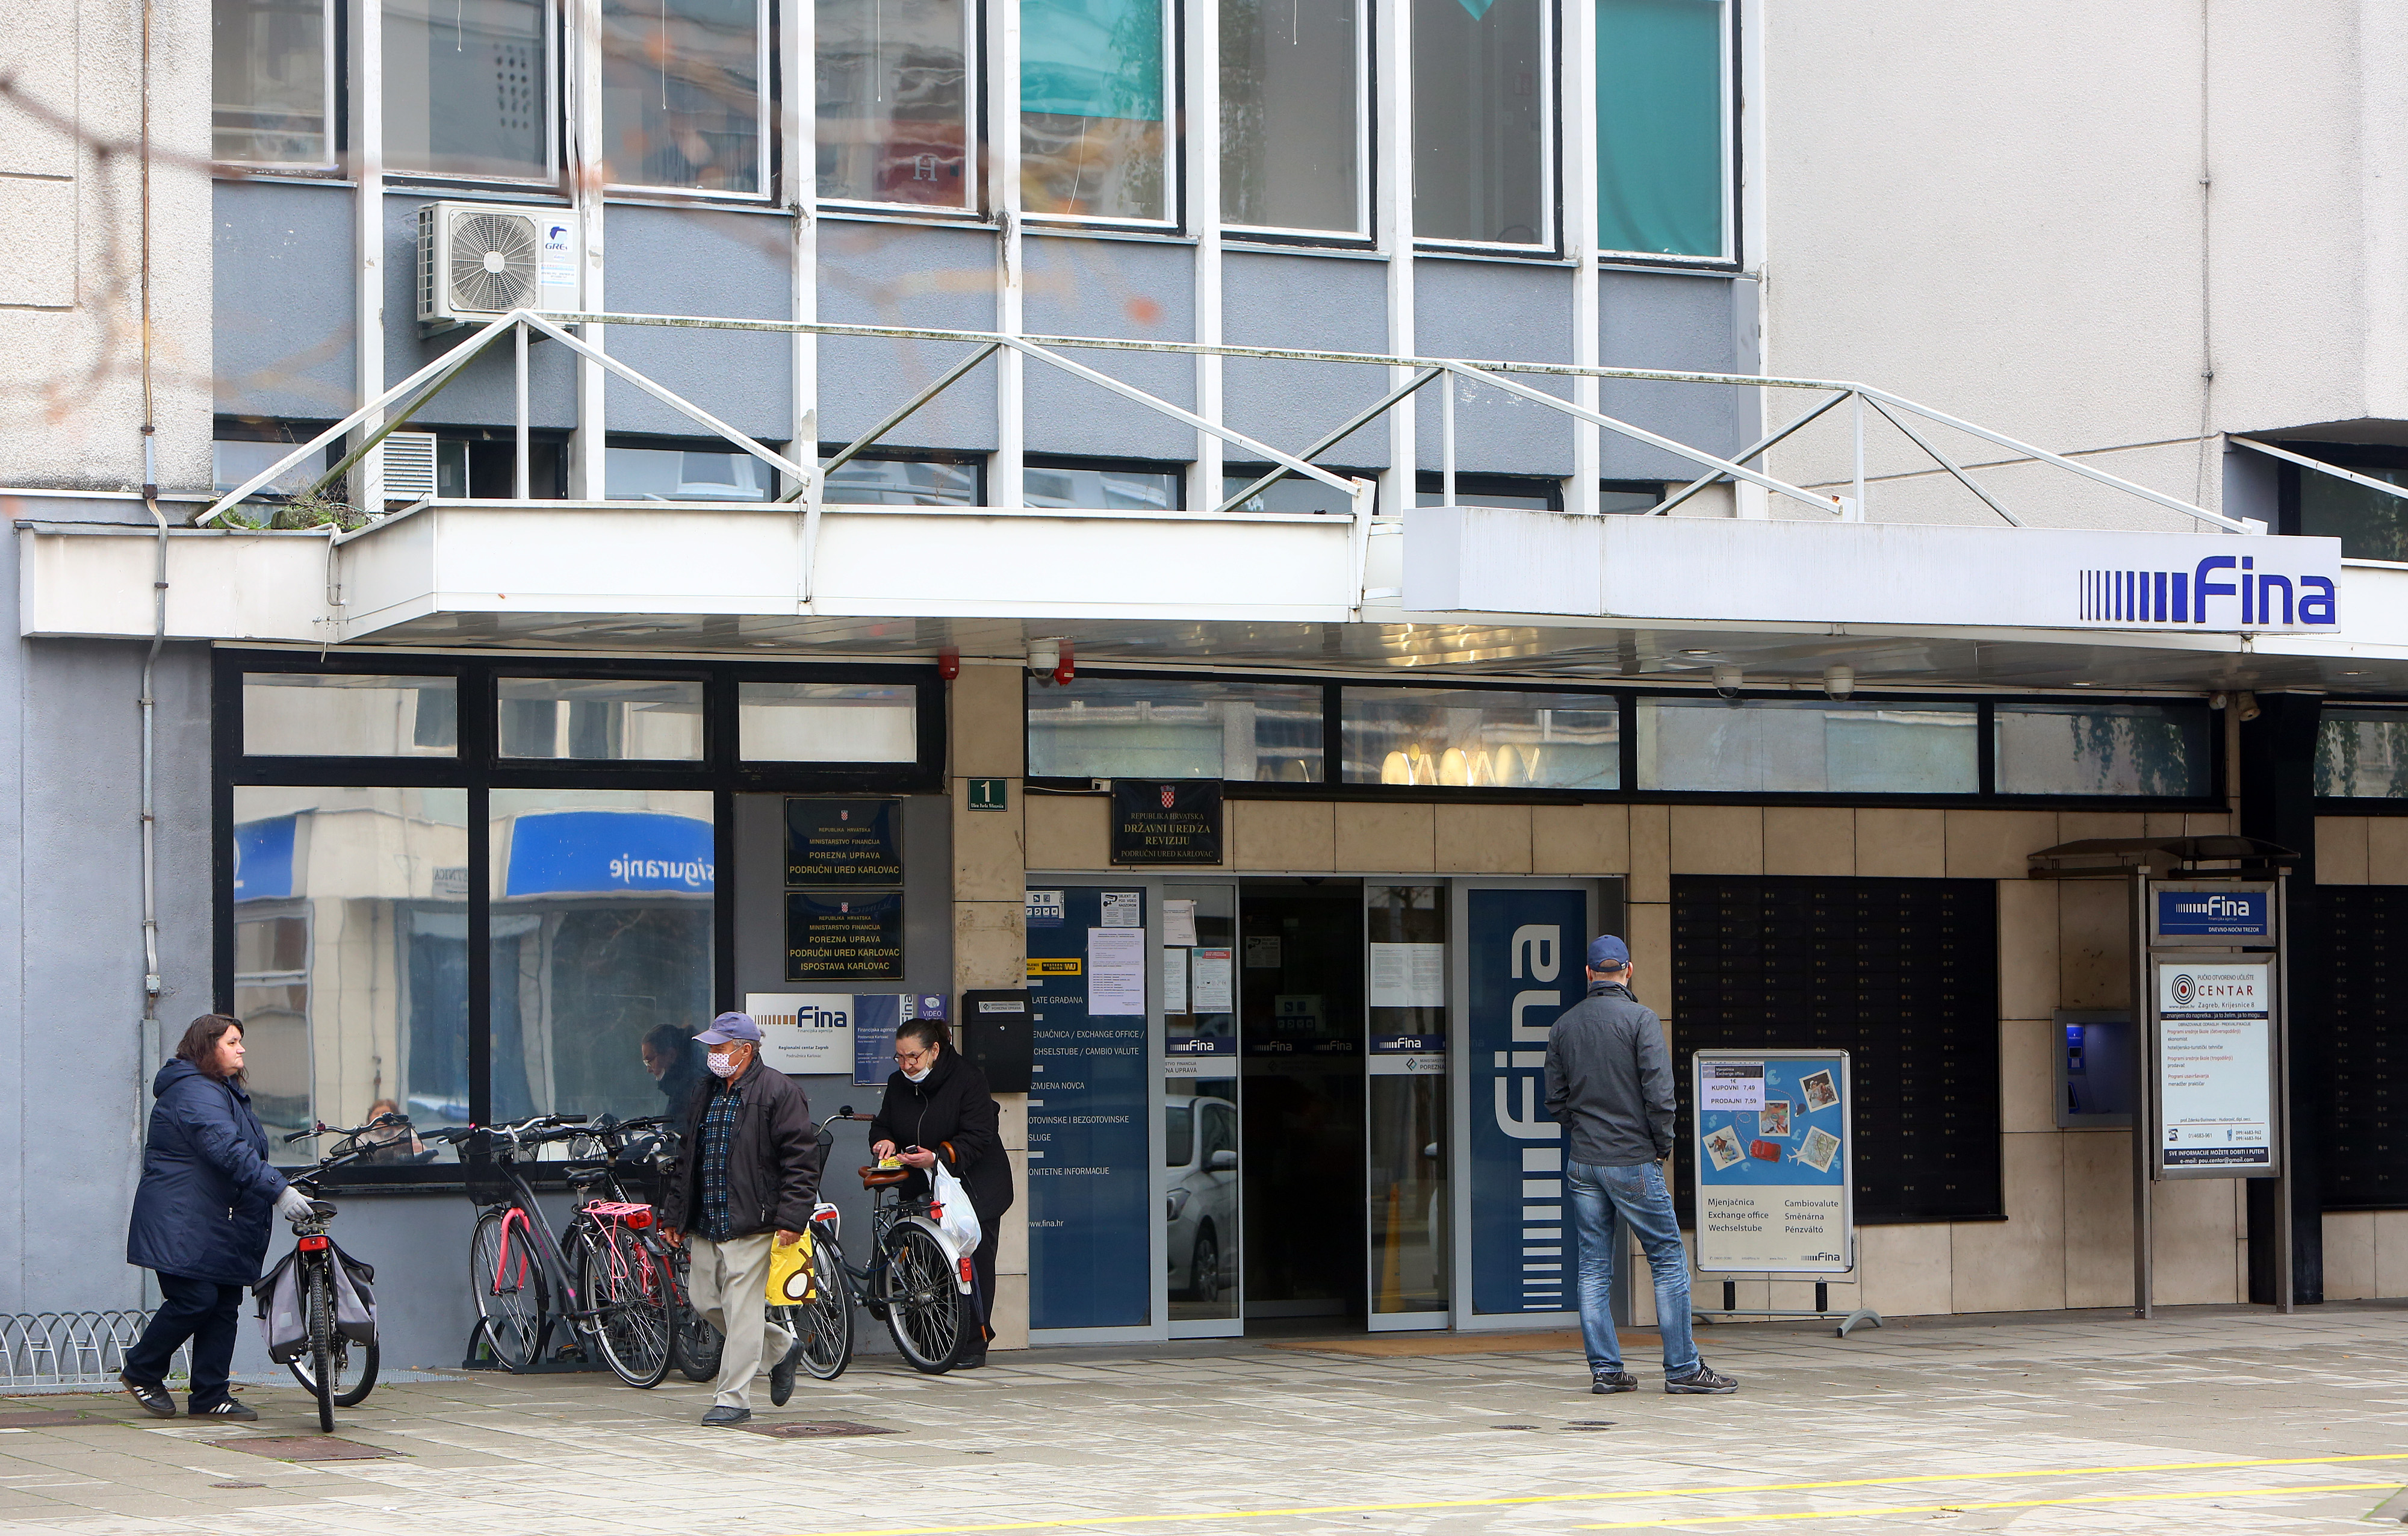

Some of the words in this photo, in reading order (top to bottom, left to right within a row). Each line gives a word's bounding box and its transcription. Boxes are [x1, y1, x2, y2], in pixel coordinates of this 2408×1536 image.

[2194, 555, 2336, 624] Fina
[981, 780, 990, 803] 1
[1124, 821, 1166, 833] DRŽAVNI
[1170, 824, 1196, 833] URED
[1197, 824, 1210, 833] ZA
[1145, 836, 1190, 845] REVIZIJU
[790, 864, 832, 874] PODRUČNI
[2208, 895, 2250, 916] Fina
[790, 947, 831, 957] PODRUČNI
[2199, 986, 2253, 996] CENTAR
[798, 1006, 847, 1028] Fina
[1495, 924, 1561, 1139] Fina
[1190, 1040, 1214, 1051] Fina
[1270, 1041, 1292, 1051] Fina
[1330, 1040, 1352, 1051] Fina
[1397, 1037, 1421, 1048] Fina
[1708, 1198, 1754, 1207] Mjenjačnica
[1708, 1211, 1745, 1220] Exchange
[1817, 1252, 1840, 1261] Fina
